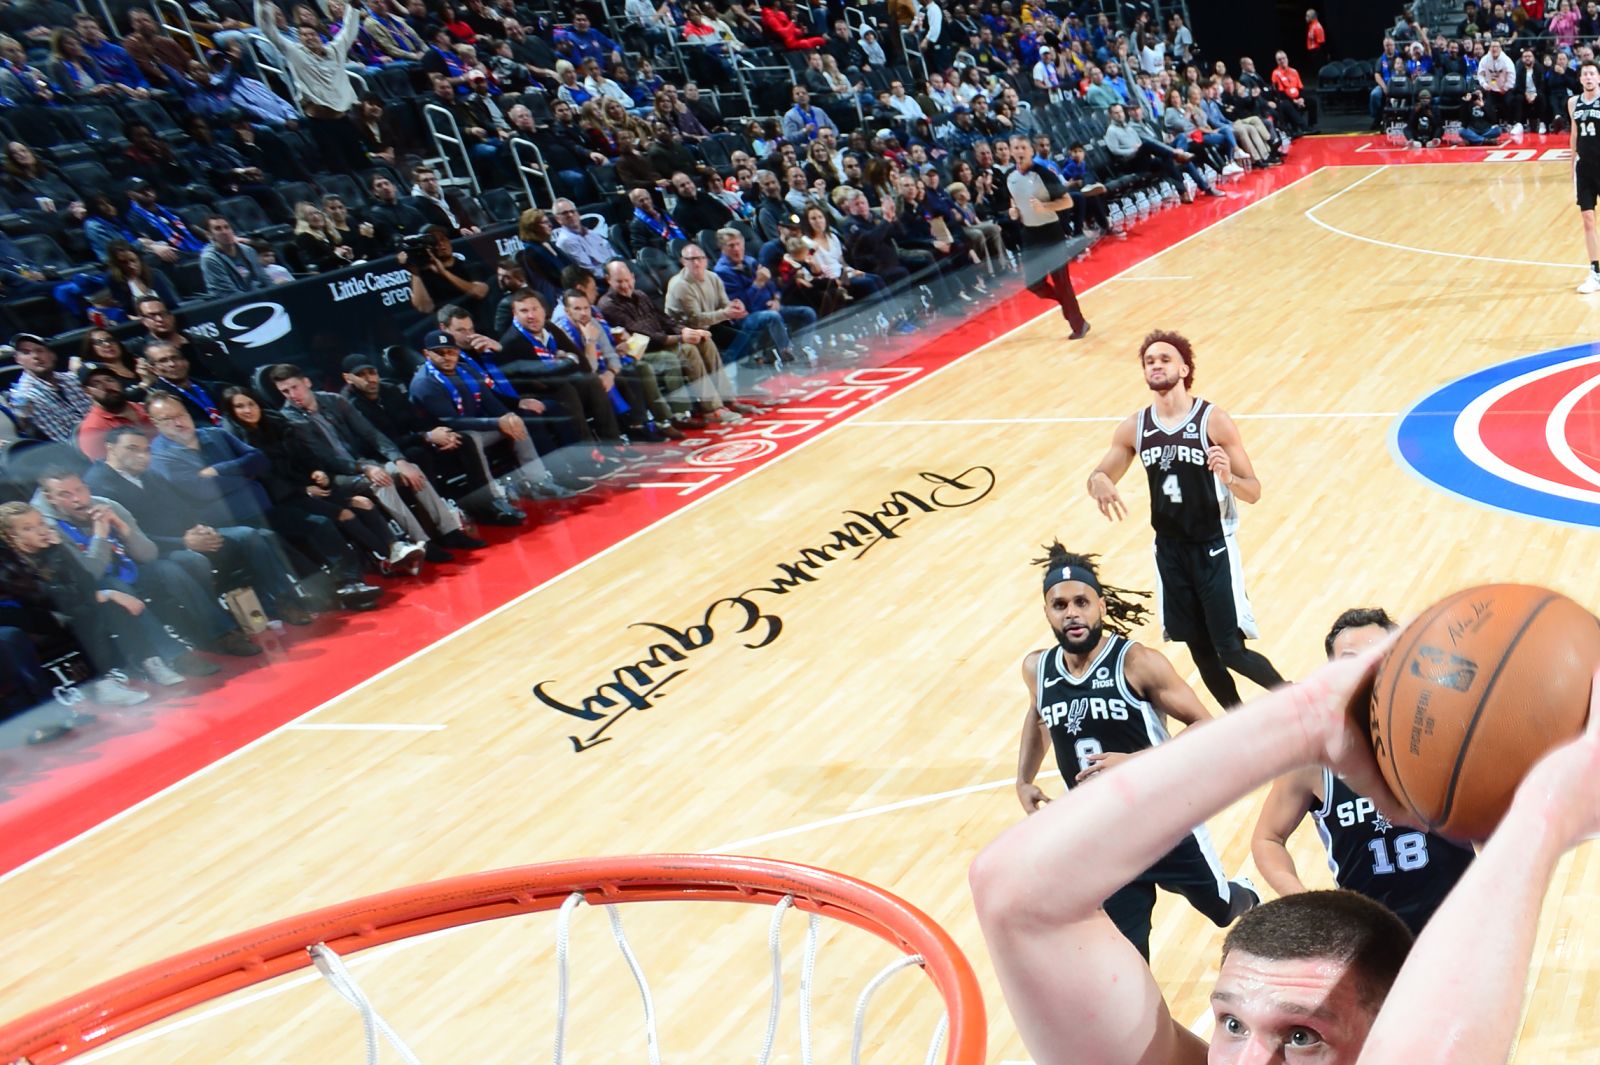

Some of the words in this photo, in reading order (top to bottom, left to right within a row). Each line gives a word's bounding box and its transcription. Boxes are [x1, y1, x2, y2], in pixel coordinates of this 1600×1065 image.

[1580, 122, 1596, 136] 14
[328, 277, 368, 302] Little
[381, 286, 413, 306] aren
[1141, 444, 1205, 472] SPURS
[1162, 474, 1183, 503] 4
[742, 466, 996, 595] Platinum
[532, 596, 783, 753] Equity
[1092, 678, 1114, 689] Frost
[1041, 697, 1129, 736] SPURS
[1368, 831, 1429, 875] 18
